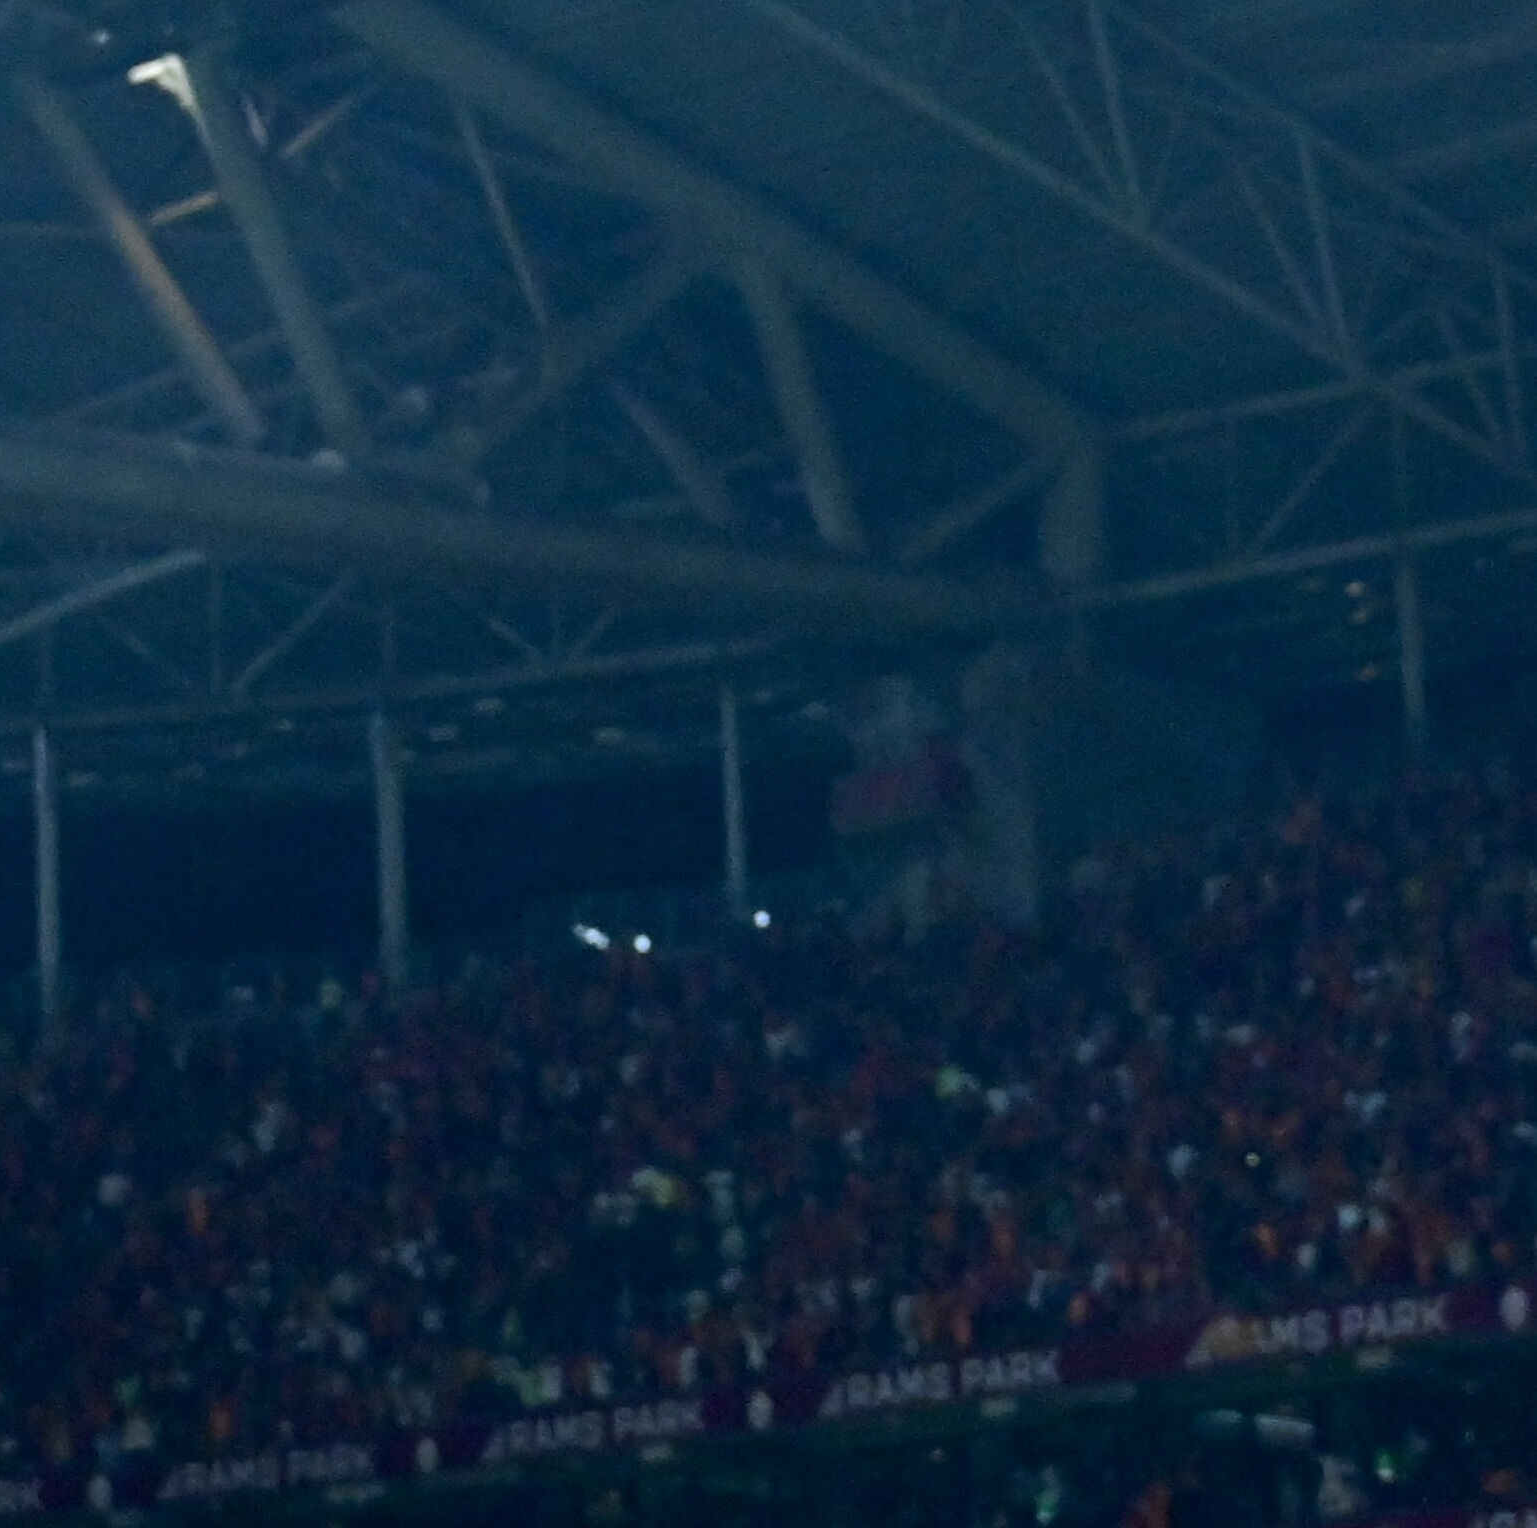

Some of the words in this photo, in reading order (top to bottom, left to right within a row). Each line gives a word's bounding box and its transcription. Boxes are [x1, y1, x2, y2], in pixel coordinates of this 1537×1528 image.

[1339, 1295, 1448, 1341] PARK
[846, 1362, 951, 1408] RAMS
[960, 1352, 1060, 1395] PARK
